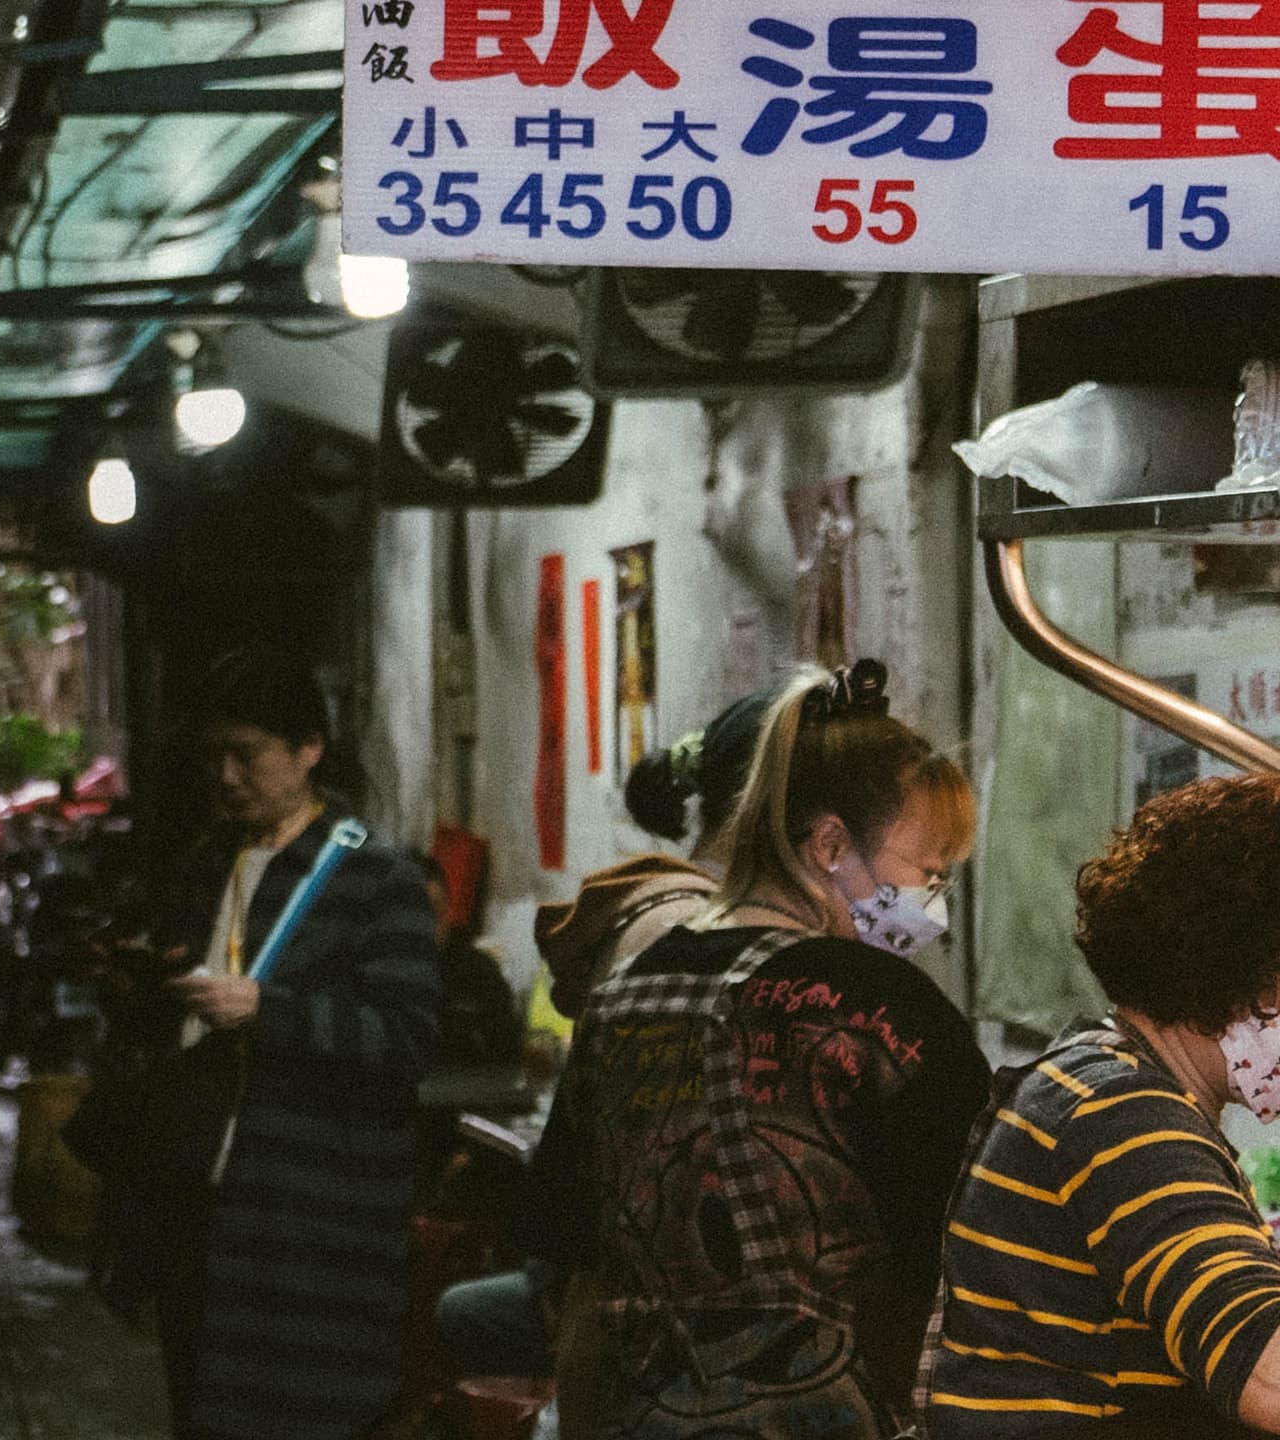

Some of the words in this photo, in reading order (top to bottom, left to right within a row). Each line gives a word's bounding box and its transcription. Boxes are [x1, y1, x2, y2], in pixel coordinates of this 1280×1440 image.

[390, 105, 469, 160] 小
[512, 108, 597, 162] 中
[641, 110, 719, 162] 大
[375, 169, 482, 239] 35
[499, 170, 608, 241] 45
[626, 173, 734, 243] 50
[810, 178, 919, 246] 55
[1127, 184, 1233, 253] 15
